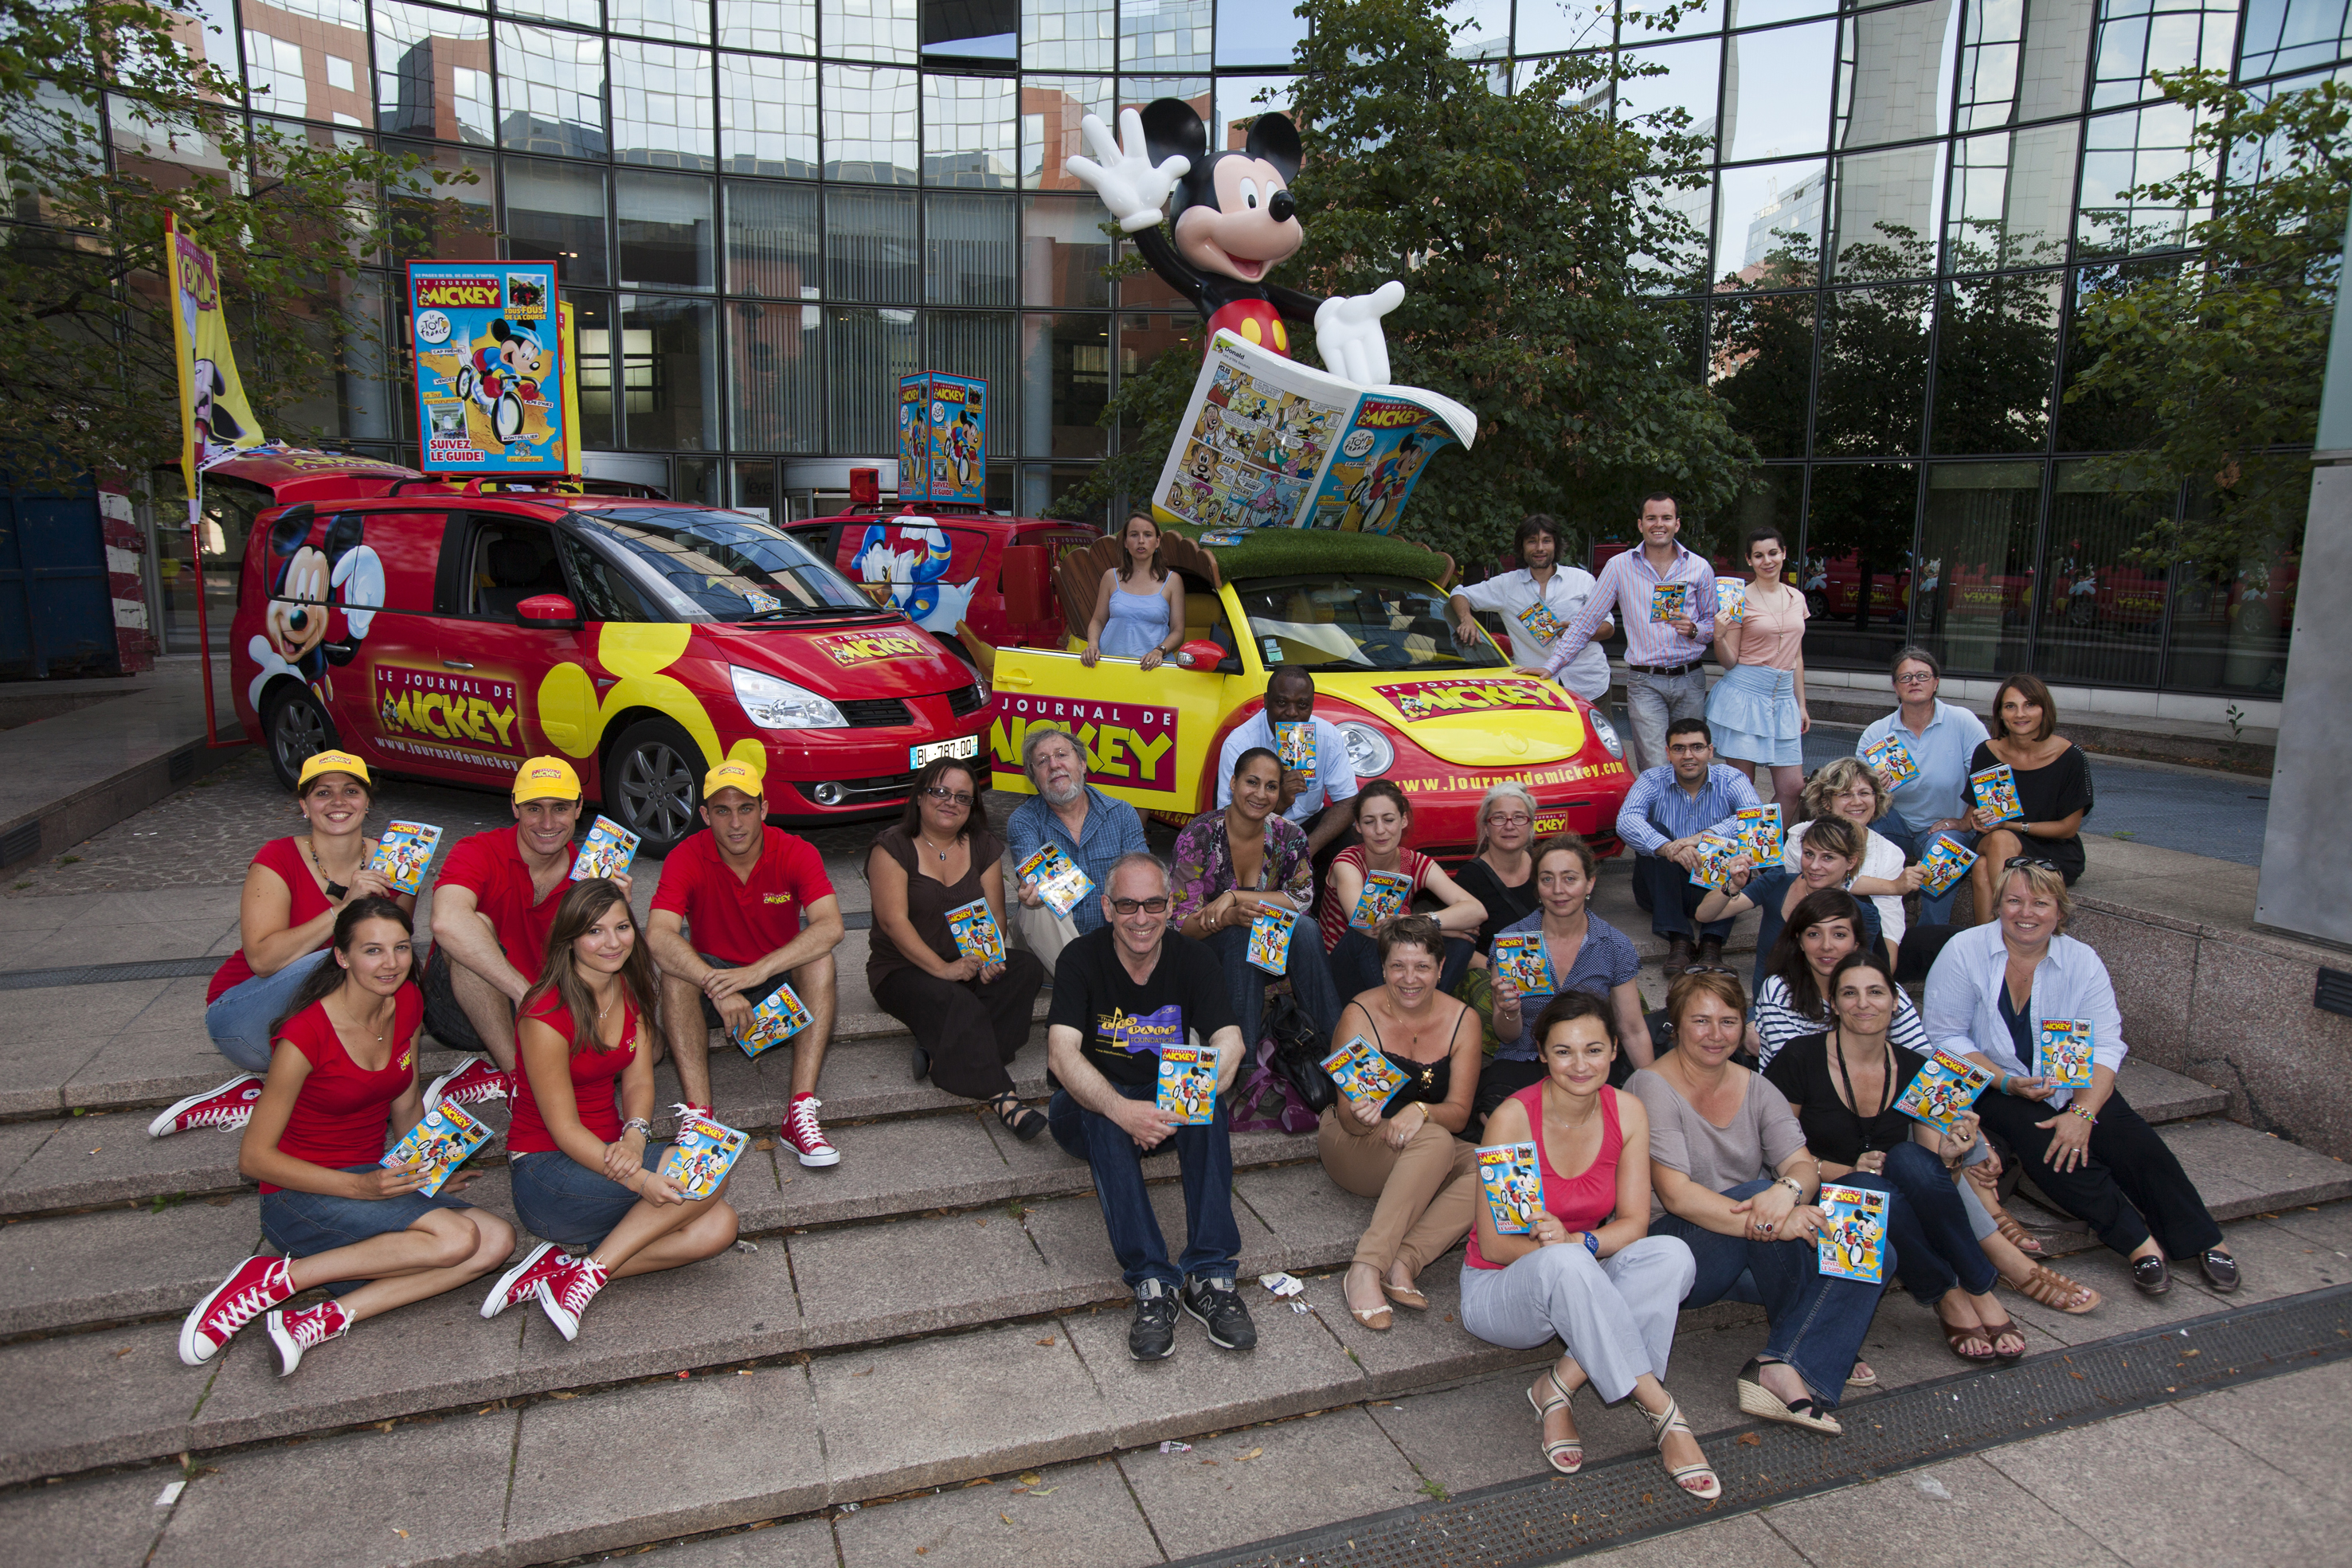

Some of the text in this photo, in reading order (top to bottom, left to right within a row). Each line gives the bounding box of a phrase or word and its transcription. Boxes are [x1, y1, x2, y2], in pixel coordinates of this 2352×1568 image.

[419, 286, 499, 306] MICKEY
[522, 306, 543, 315] FOUS
[1224, 345, 1245, 360] Donald
[902, 389, 919, 403] MICKEY
[933, 388, 965, 401] MICKEY
[1357, 409, 1428, 427] MICKEY
[430, 440, 471, 449] SUIVEZ
[430, 451, 484, 461] LE GUIDE!
[837, 632, 890, 642] JOURNAL
[829, 637, 926, 664] MICKEY
[378, 669, 512, 699] LE JOURNAL DE
[1416, 679, 1506, 689] JOURNAL
[1397, 685, 1557, 718] MICKEY
[382, 687, 517, 748] MICKEY
[1001, 698, 1171, 725] JOURNAL DE
[1973, 774, 1996, 784] MICKEY
[1737, 811, 1762, 819] MICKEY
[595, 821, 623, 838] MICKEY
[1937, 839, 1961, 854] MICKEY
[1022, 854, 1043, 876] MICKEY
[1369, 877, 1395, 886] MICKEY
[949, 910, 971, 924] MICKEY
[1497, 939, 1524, 948] MICKEY
[777, 990, 799, 1013] MICKEY
[1106, 1018, 1135, 1030] LES
[1163, 1051, 1197, 1062] MICKEY
[1327, 1053, 1350, 1073] MICKEY
[1933, 1054, 1968, 1075] MICKEY
[1899, 1100, 1917, 1111] SUIVEZ
[439, 1103, 470, 1128] MICKEY
[693, 1120, 724, 1140] MICKEY
[1480, 1152, 1513, 1165] MICKEY
